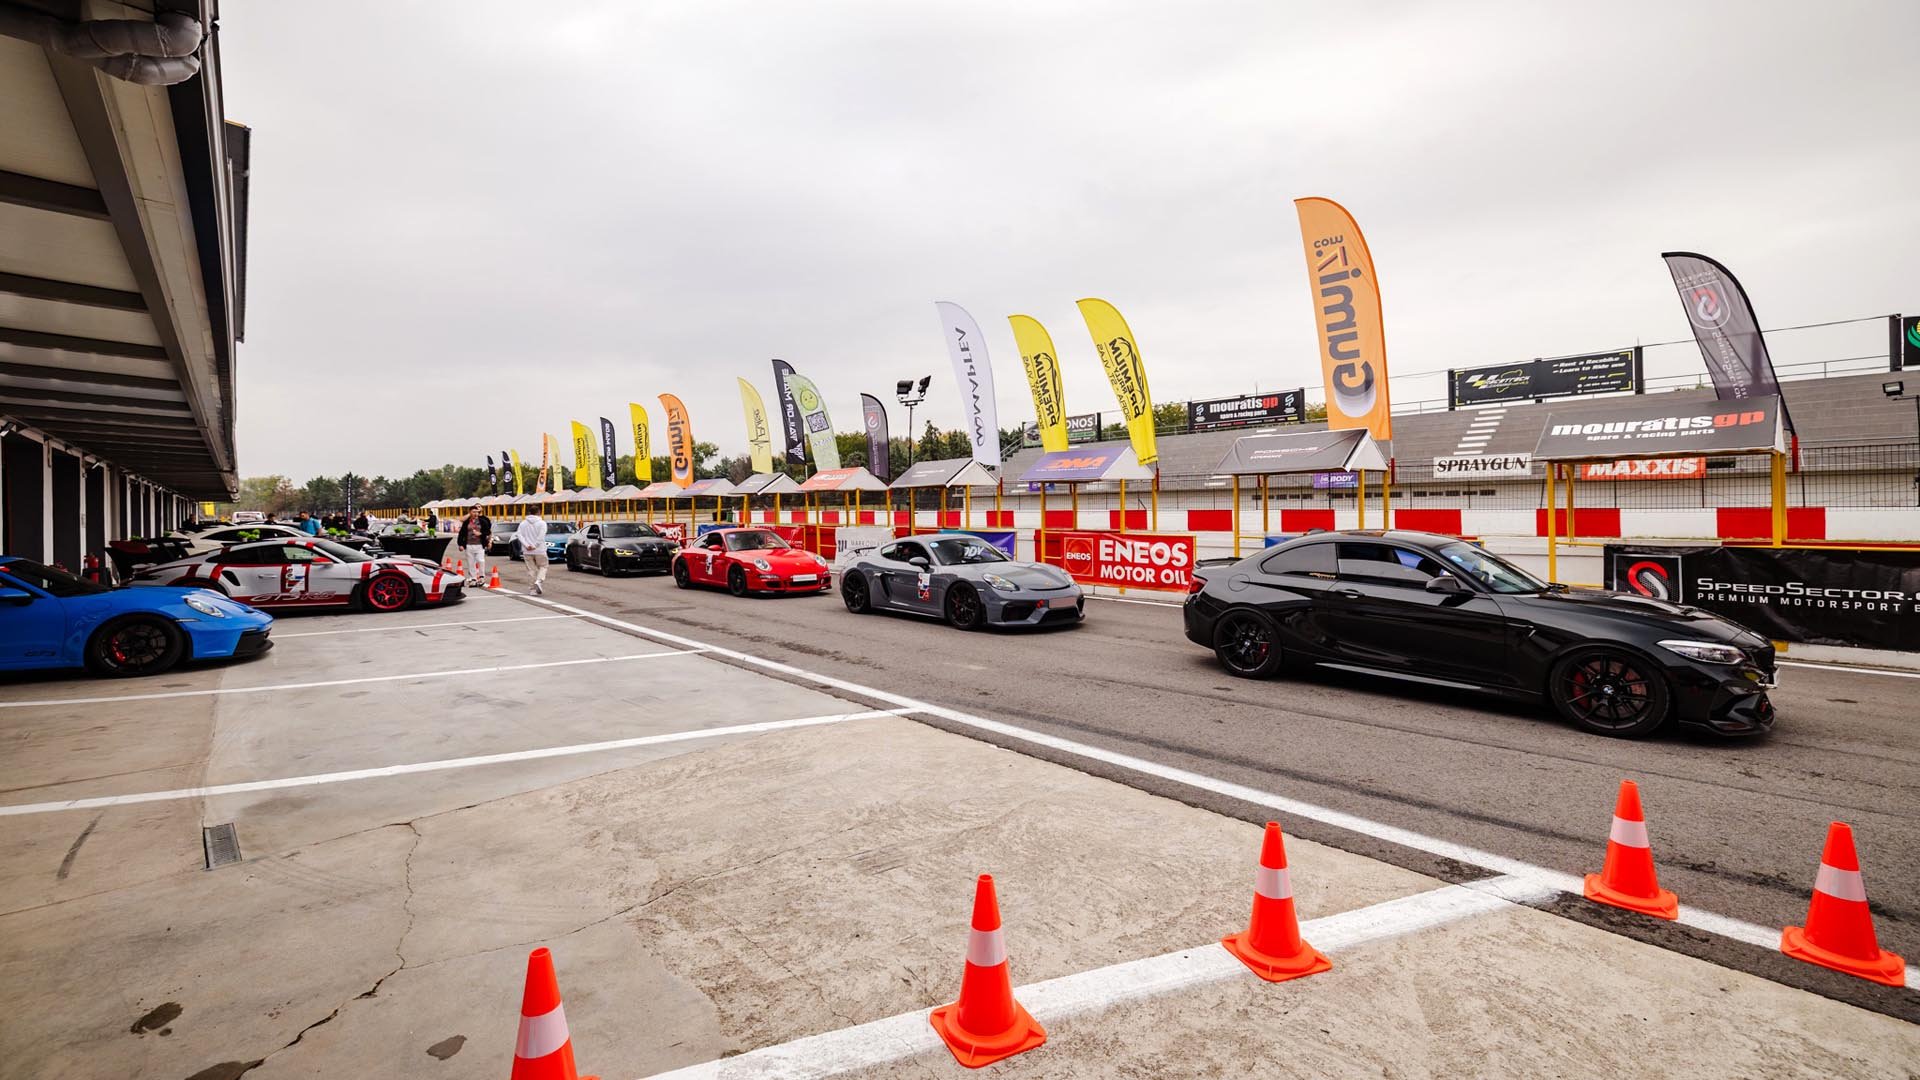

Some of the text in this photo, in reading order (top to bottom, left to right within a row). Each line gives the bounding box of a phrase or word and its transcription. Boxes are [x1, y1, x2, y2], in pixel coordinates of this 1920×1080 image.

[1209, 396, 1279, 413] mouratisgp
[1551, 411, 1765, 436] mouratisgp
[1680, 428, 1715, 436] parts
[1436, 457, 1527, 473] SPRAYGUN
[1587, 457, 1699, 476] MAXXIS
[1066, 552, 1092, 561] ENEOS
[1099, 540, 1188, 567] ENEOS
[1100, 565, 1189, 585] MOTOR OIL
[1698, 592, 1769, 604] PREMIUM
[1780, 598, 1901, 612] MOTORSPORT
